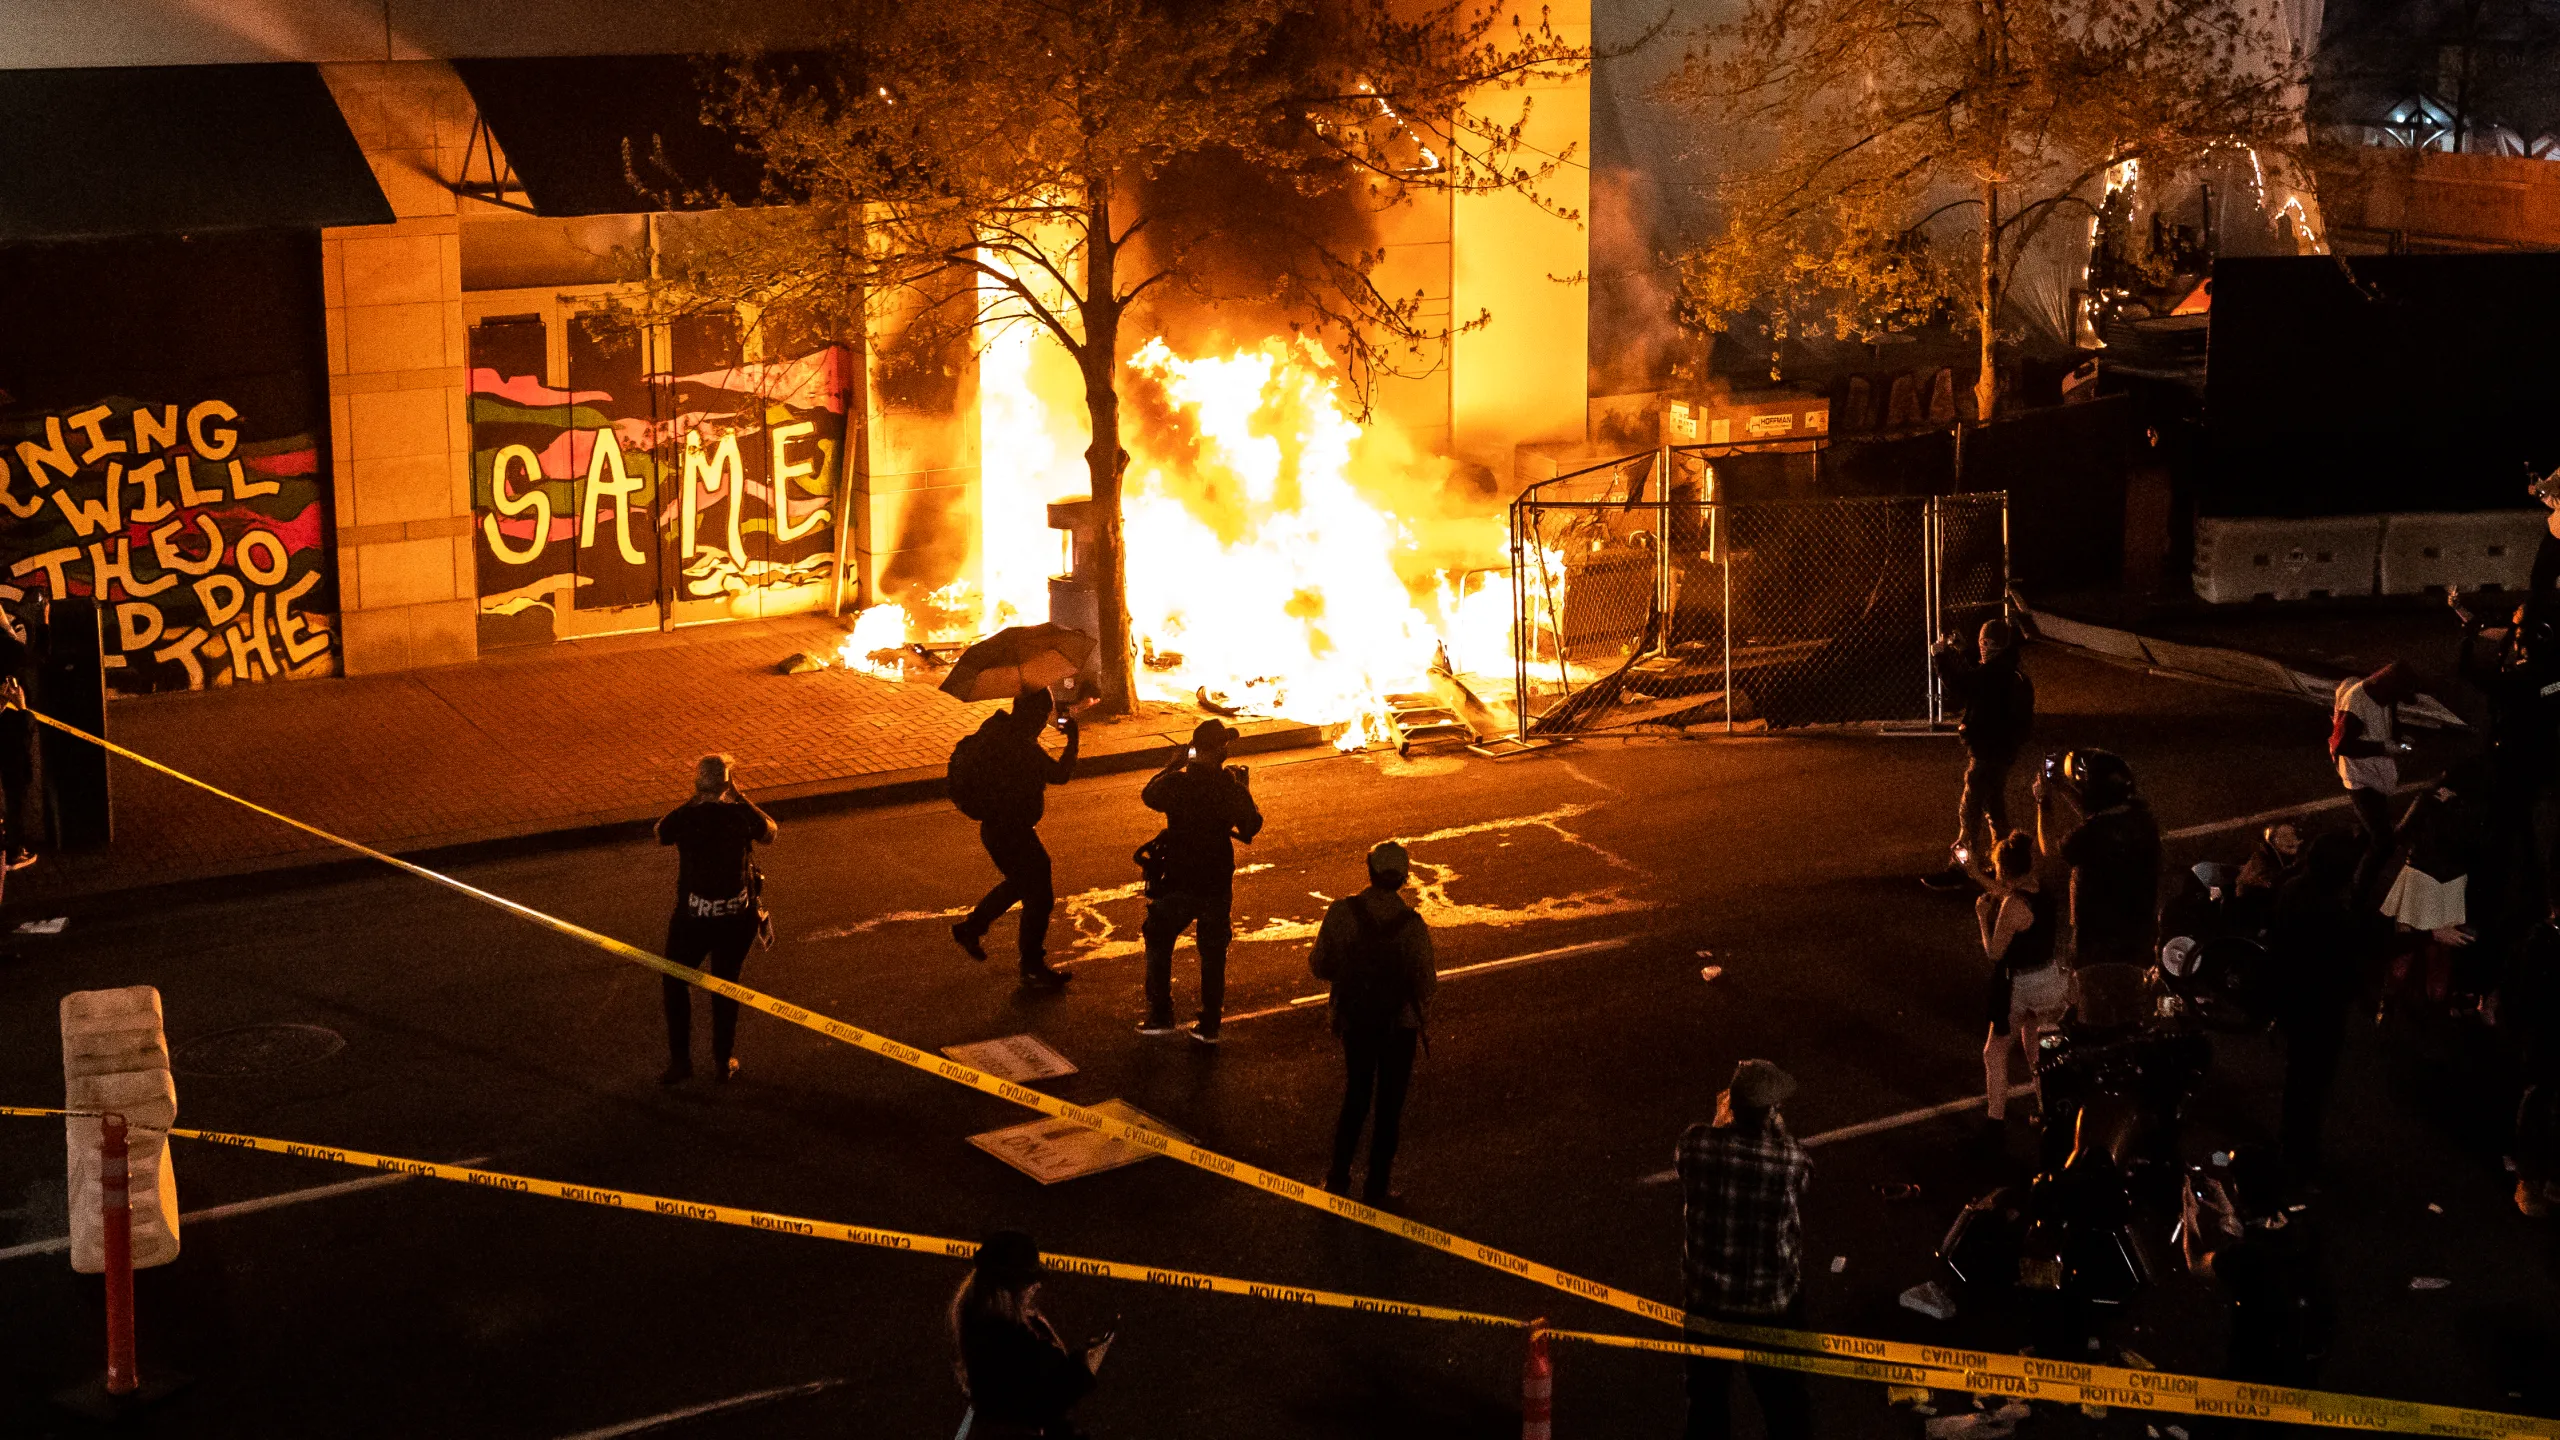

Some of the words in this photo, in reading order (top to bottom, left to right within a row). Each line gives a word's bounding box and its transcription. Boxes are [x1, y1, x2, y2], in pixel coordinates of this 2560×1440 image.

[1761, 416, 1791, 425] HOFFMAN
[52, 456, 280, 536] WILL
[484, 421, 831, 571] SAME
[155, 571, 330, 690] THE
[287, 1144, 346, 1162] CAUTION
[377, 1158, 436, 1177] CAUTION
[468, 1172, 529, 1193] CAUTION
[561, 1186, 622, 1206] CAUTION
[655, 1200, 717, 1221] CAUTION
[751, 1215, 813, 1235] CAUTION
[848, 1229, 911, 1250] CAUTION
[1045, 1256, 1110, 1277] CAUTION
[1147, 1270, 1212, 1291] CAUTION
[1250, 1285, 1316, 1305] CAUTION
[1966, 1373, 2039, 1395] CAUTION
[2080, 1386, 2154, 1407] CAUTION
[2194, 1396, 2270, 1418] CAUTION
[2312, 1411, 2387, 1427] CAUTION
